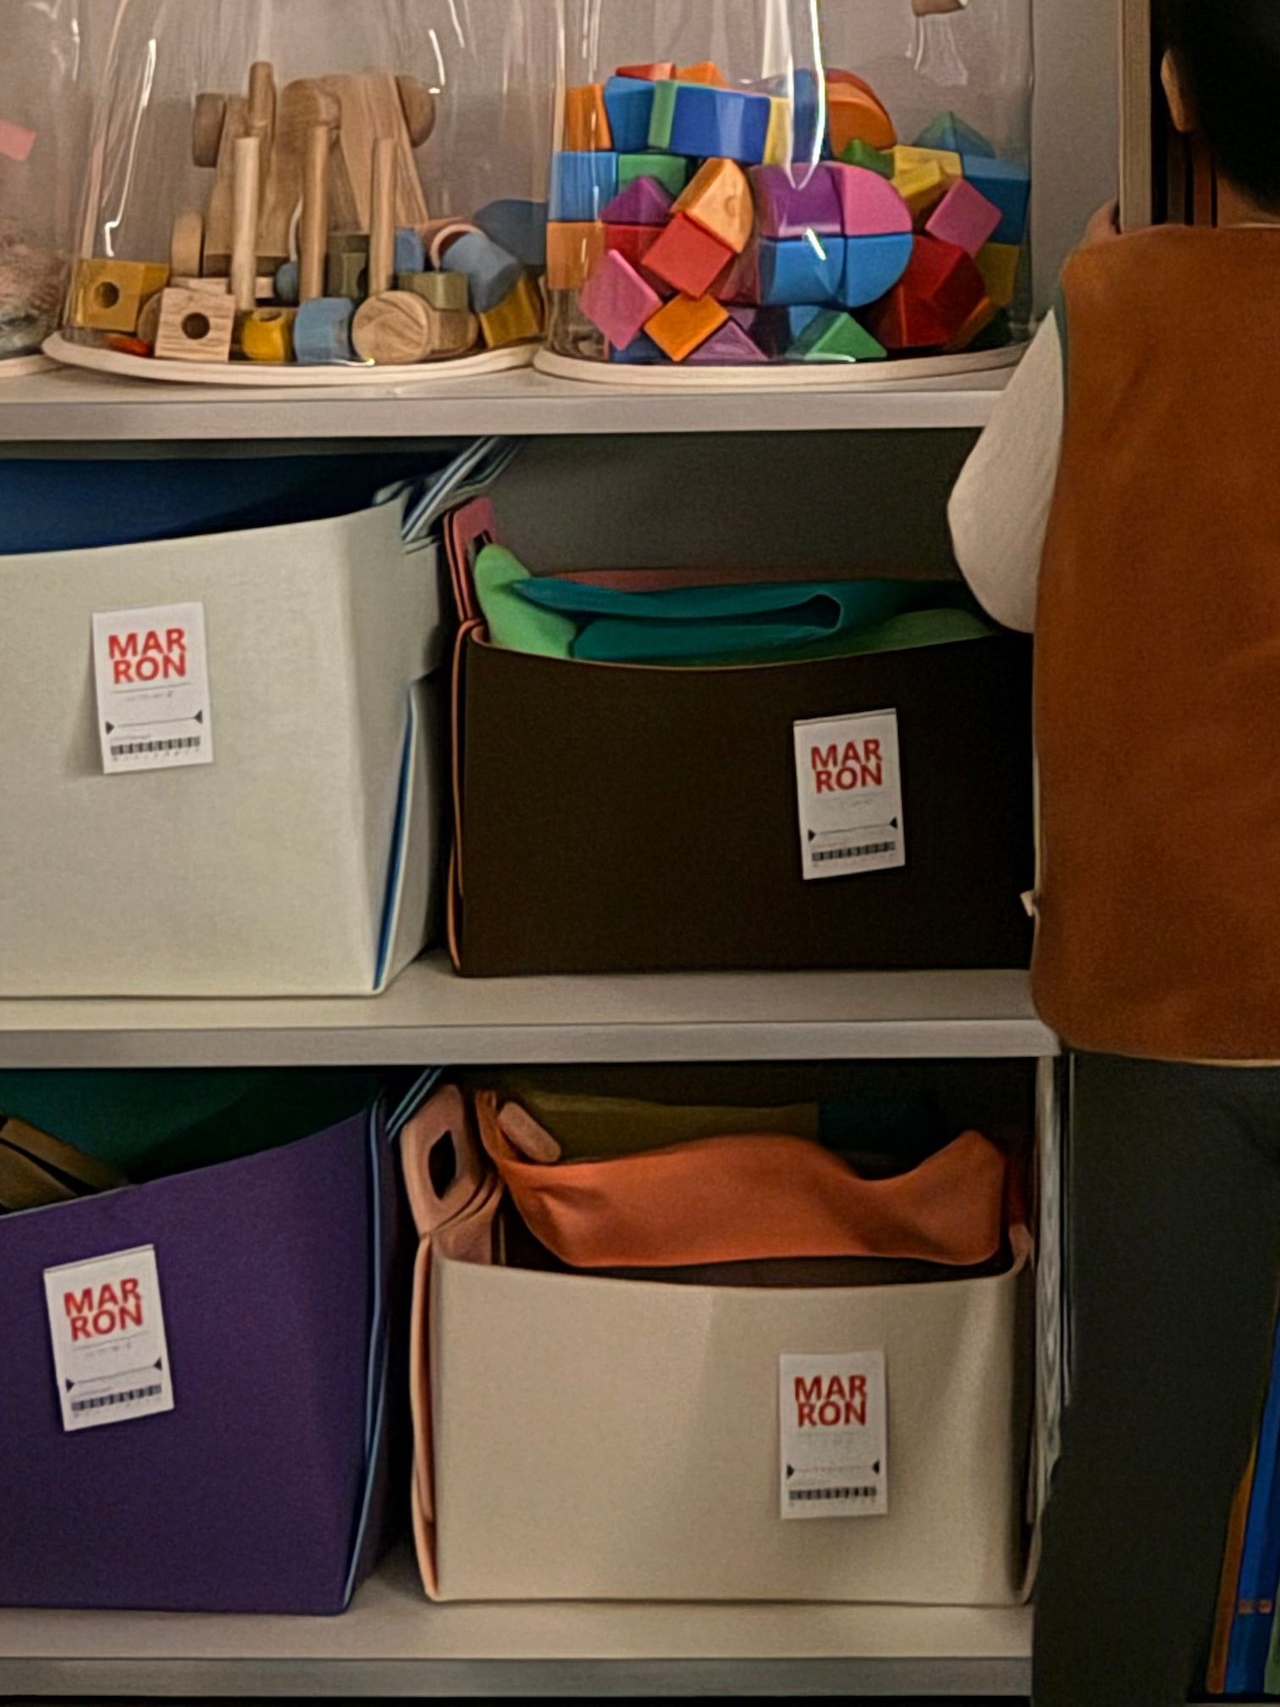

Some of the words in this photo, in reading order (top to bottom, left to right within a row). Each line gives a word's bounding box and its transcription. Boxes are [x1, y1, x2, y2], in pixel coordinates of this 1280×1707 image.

[109, 627, 187, 660] MAR
[113, 653, 186, 685] RON
[810, 738, 883, 771] MAR
[815, 762, 883, 794] RON
[63, 1277, 142, 1318] MAR
[69, 1302, 143, 1342] RON
[794, 1374, 867, 1402] MAR
[797, 1399, 867, 1428] RON
